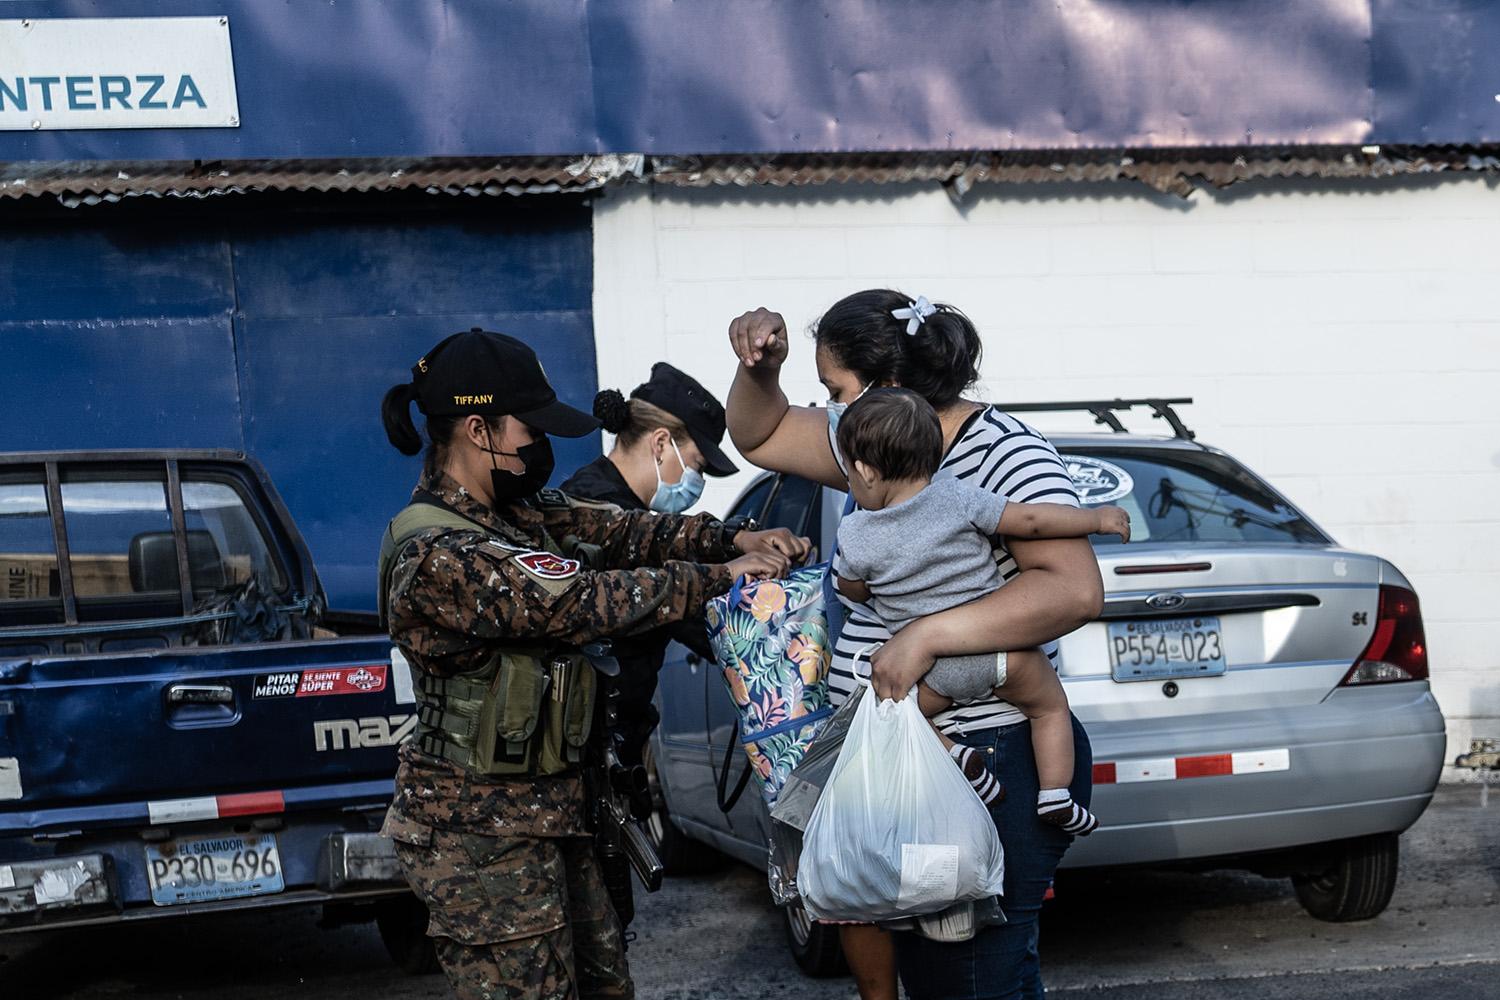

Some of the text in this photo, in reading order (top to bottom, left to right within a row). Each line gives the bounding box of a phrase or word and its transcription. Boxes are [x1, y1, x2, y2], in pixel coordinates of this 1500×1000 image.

[0, 74, 208, 111] NTERZA
[453, 394, 494, 405] TIFFANY
[267, 672, 299, 686] PITAR
[314, 671, 341, 681] SIENTE
[255, 684, 297, 697] MENOS
[180, 839, 244, 855] EL SALVADOR
